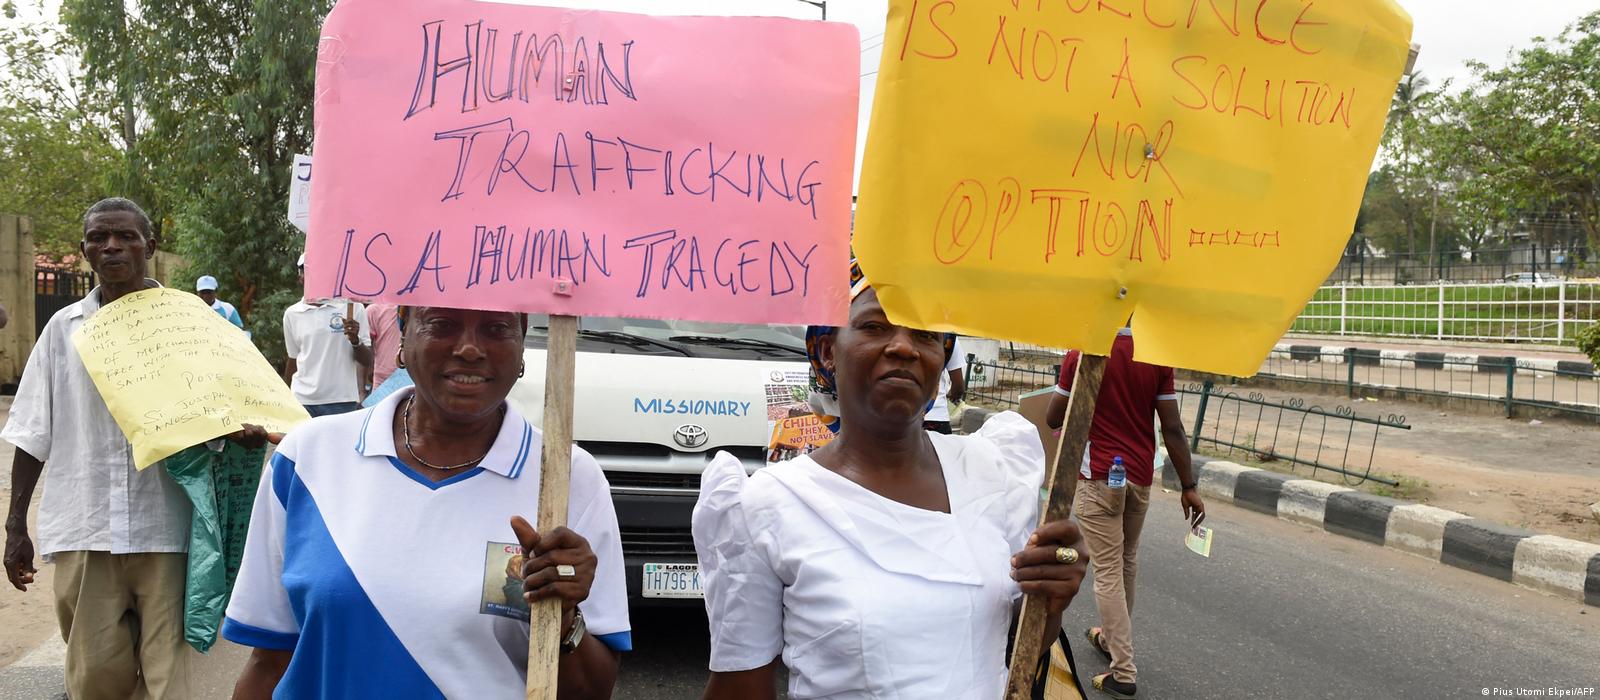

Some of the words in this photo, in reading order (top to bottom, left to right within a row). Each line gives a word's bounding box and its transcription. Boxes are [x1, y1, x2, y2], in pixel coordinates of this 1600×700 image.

[403, 19, 637, 121] HUMAN
[900, 0, 958, 61] IS
[988, 15, 1085, 92] NOT
[1110, 37, 1142, 108] A
[1171, 55, 1356, 129] SOLUTION
[434, 117, 822, 220] TRAFFICKING
[1071, 111, 1185, 200] NOR
[333, 229, 392, 298] IS
[397, 229, 452, 296] A
[466, 225, 612, 289] HUMAN
[623, 229, 818, 298] TRAGEDY
[934, 177, 1173, 264] OPTION
[634, 397, 751, 417] MISSIONARY
[783, 416, 822, 429] CHILD
[800, 426, 822, 435] THEY
